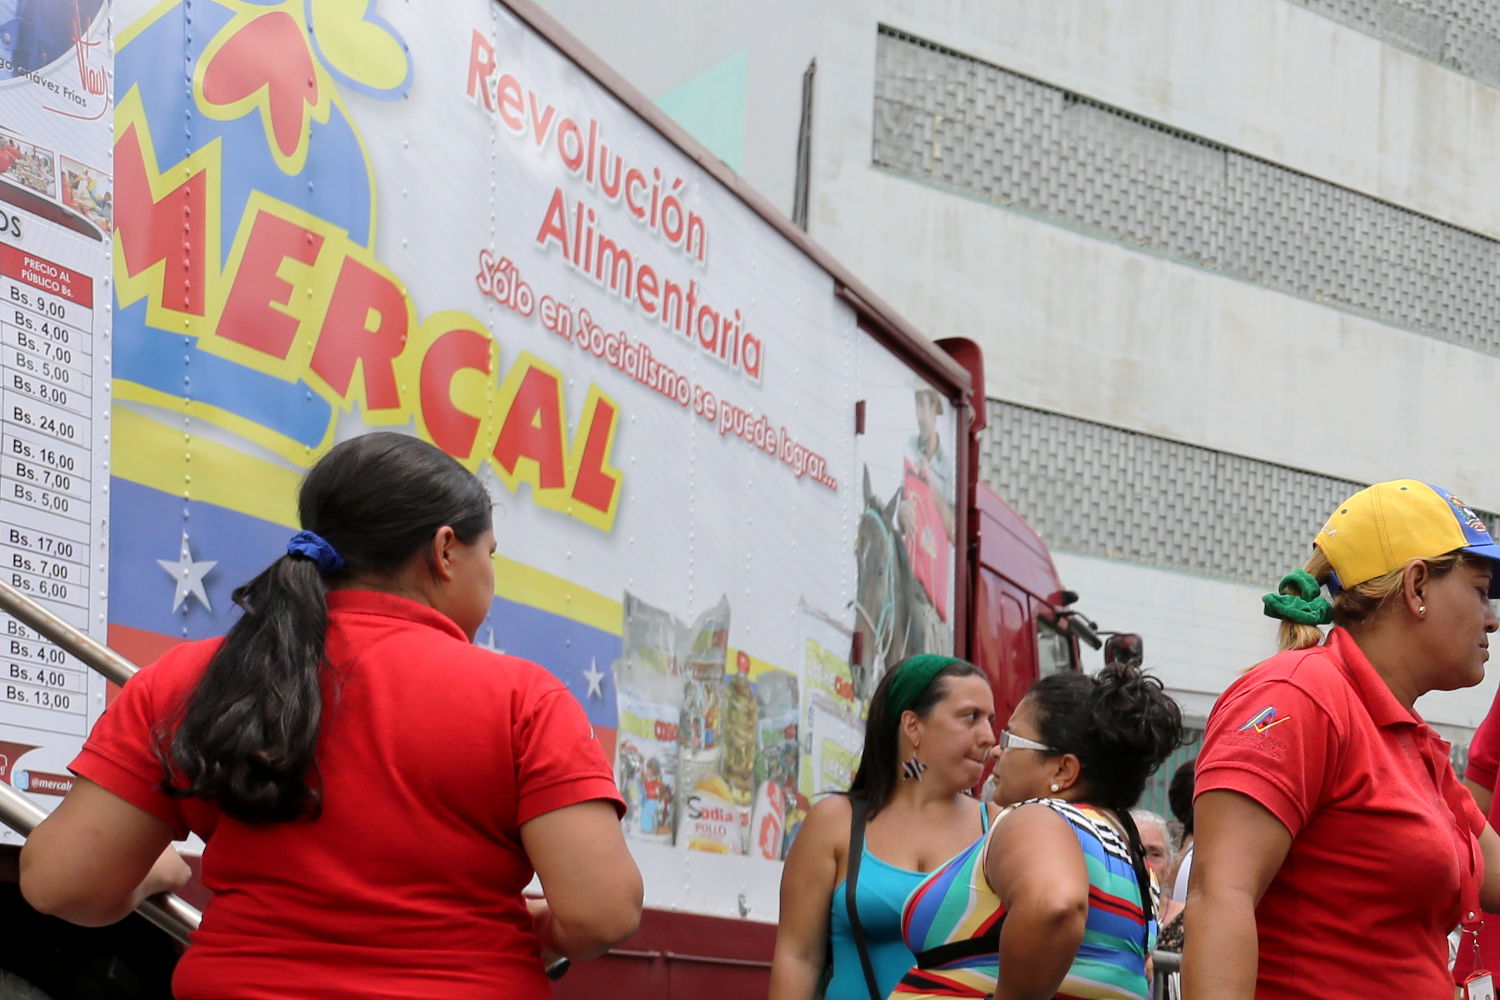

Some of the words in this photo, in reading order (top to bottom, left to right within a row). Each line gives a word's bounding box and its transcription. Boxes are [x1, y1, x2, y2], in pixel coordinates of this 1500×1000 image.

[63, 87, 87, 107] Frías
[466, 28, 706, 263] Revolución
[21, 267, 60, 291] PÚBLICO
[24, 257, 57, 277] PRECIO
[59, 271, 71, 283] AL
[536, 187, 763, 379] Alimentaria
[10, 286, 32, 307] Bs.
[38, 297, 65, 319] 9,00
[15, 311, 37, 331] Bs.
[41, 322, 69, 343] 4,00
[112, 118, 620, 516] MERCAL
[18, 332, 39, 352] Bs.
[44, 342, 71, 364] 7,00
[477, 249, 535, 317] Sólo
[539, 295, 574, 344] en
[577, 307, 690, 406] Socialismo
[694, 385, 717, 421] se
[720, 399, 777, 456] puede
[16, 353, 38, 372] Bs.
[42, 363, 69, 383] 5,00
[14, 375, 36, 394] Bs.
[40, 384, 67, 405] 8,00
[14, 407, 35, 426] Bs.
[40, 416, 74, 438] 24,00
[13, 439, 35, 459] Bs.
[40, 448, 74, 471] 16,00
[16, 463, 38, 481] Bs.
[43, 471, 70, 490] 7,00
[15, 484, 36, 502] Bs.
[42, 493, 69, 512] 5,00
[10, 530, 32, 547] Bs.
[38, 537, 72, 557] 17,00
[13, 554, 35, 572] Bs.
[40, 561, 68, 579] 7,00
[12, 574, 34, 592] Bs.
[39, 581, 67, 599] 6,00
[8, 621, 31, 637] Bs.
[10, 641, 32, 657] Bs.
[37, 646, 65, 664] 4,00
[10, 665, 32, 681] Bs.
[37, 669, 65, 686] 4,00
[7, 687, 29, 702] Bs.
[34, 691, 70, 709] 13,00
